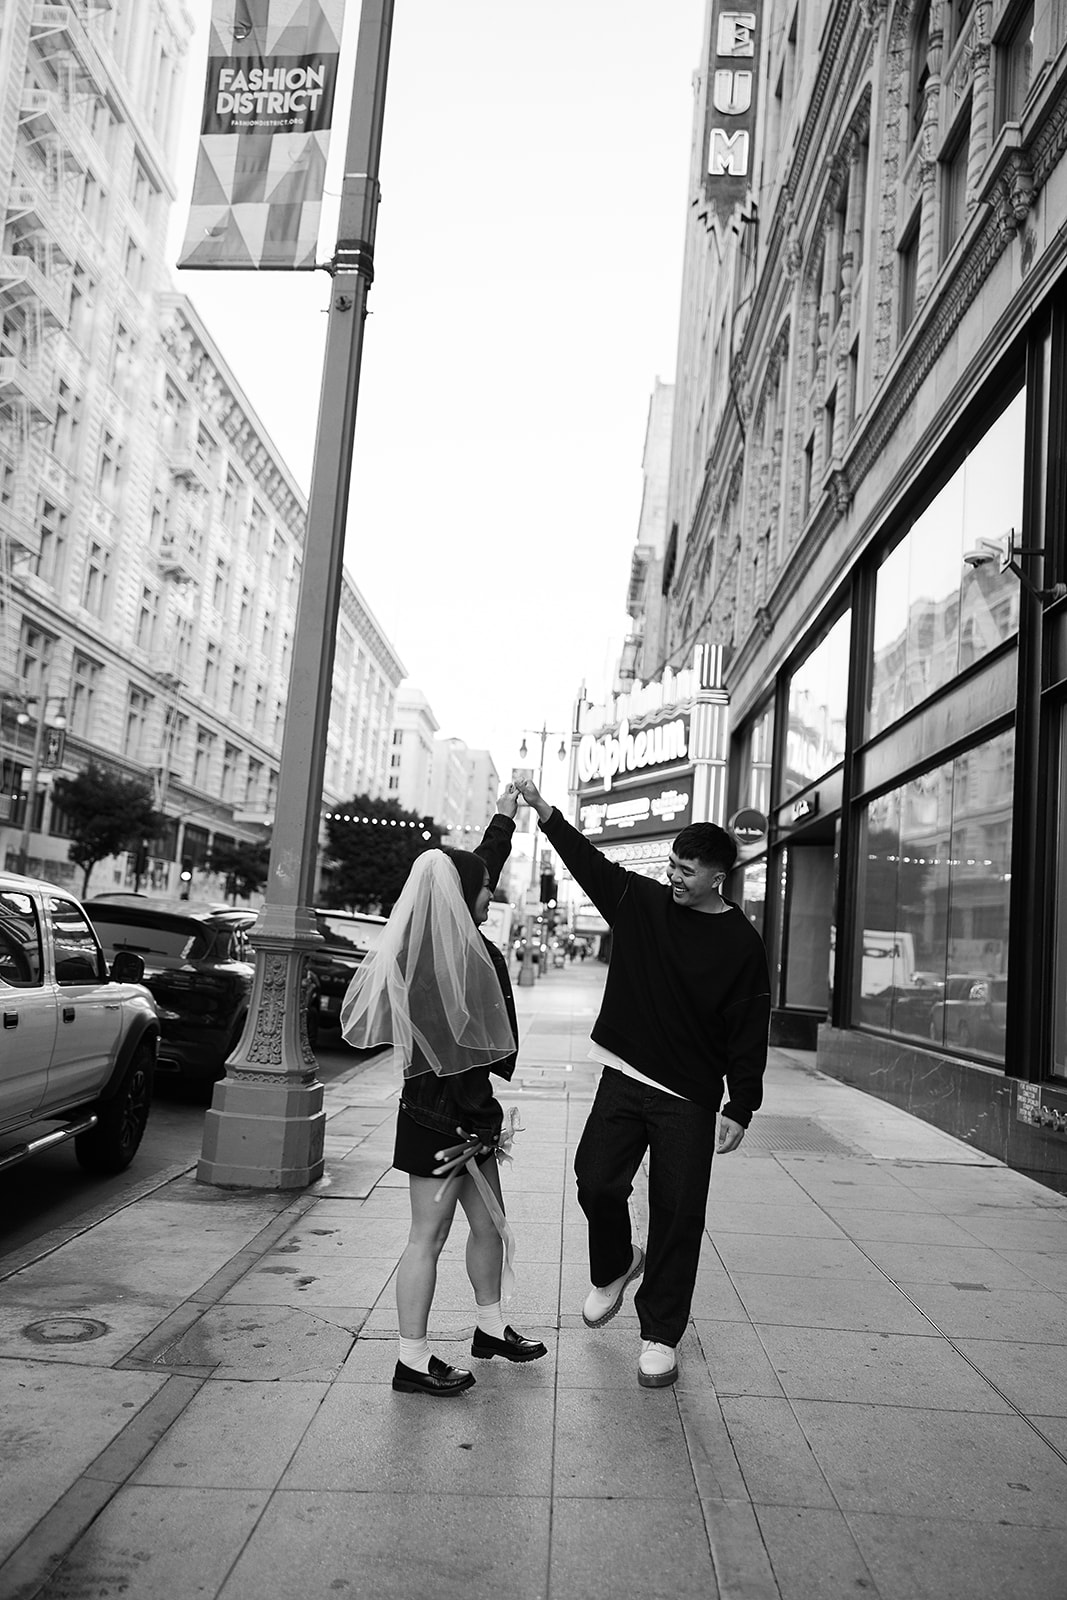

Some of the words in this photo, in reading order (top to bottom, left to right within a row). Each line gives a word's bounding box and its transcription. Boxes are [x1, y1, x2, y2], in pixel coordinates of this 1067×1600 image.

[218, 65, 325, 91] FASHION
[216, 88, 323, 114] DISTRICT
[231, 118, 304, 127] FASHIONDISTRICT.ORG
[577, 718, 688, 791] Orpheum
